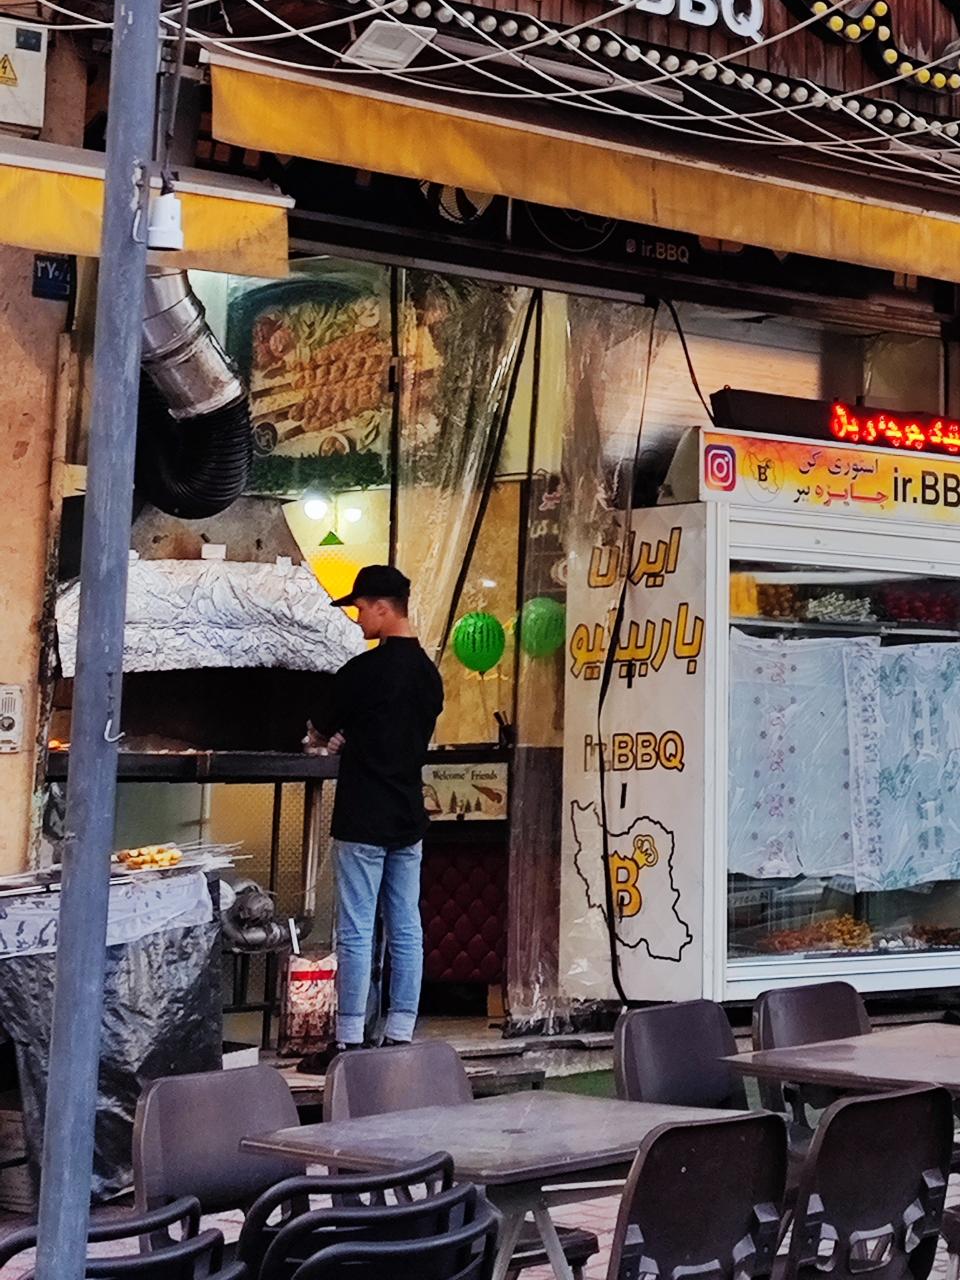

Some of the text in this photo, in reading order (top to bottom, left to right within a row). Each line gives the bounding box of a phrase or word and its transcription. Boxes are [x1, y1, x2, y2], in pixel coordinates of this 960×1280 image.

[641, 240, 689, 265] ir.BBQ
[799, 451, 878, 480] استوری کن
[815, 484, 890, 510] جایزه
